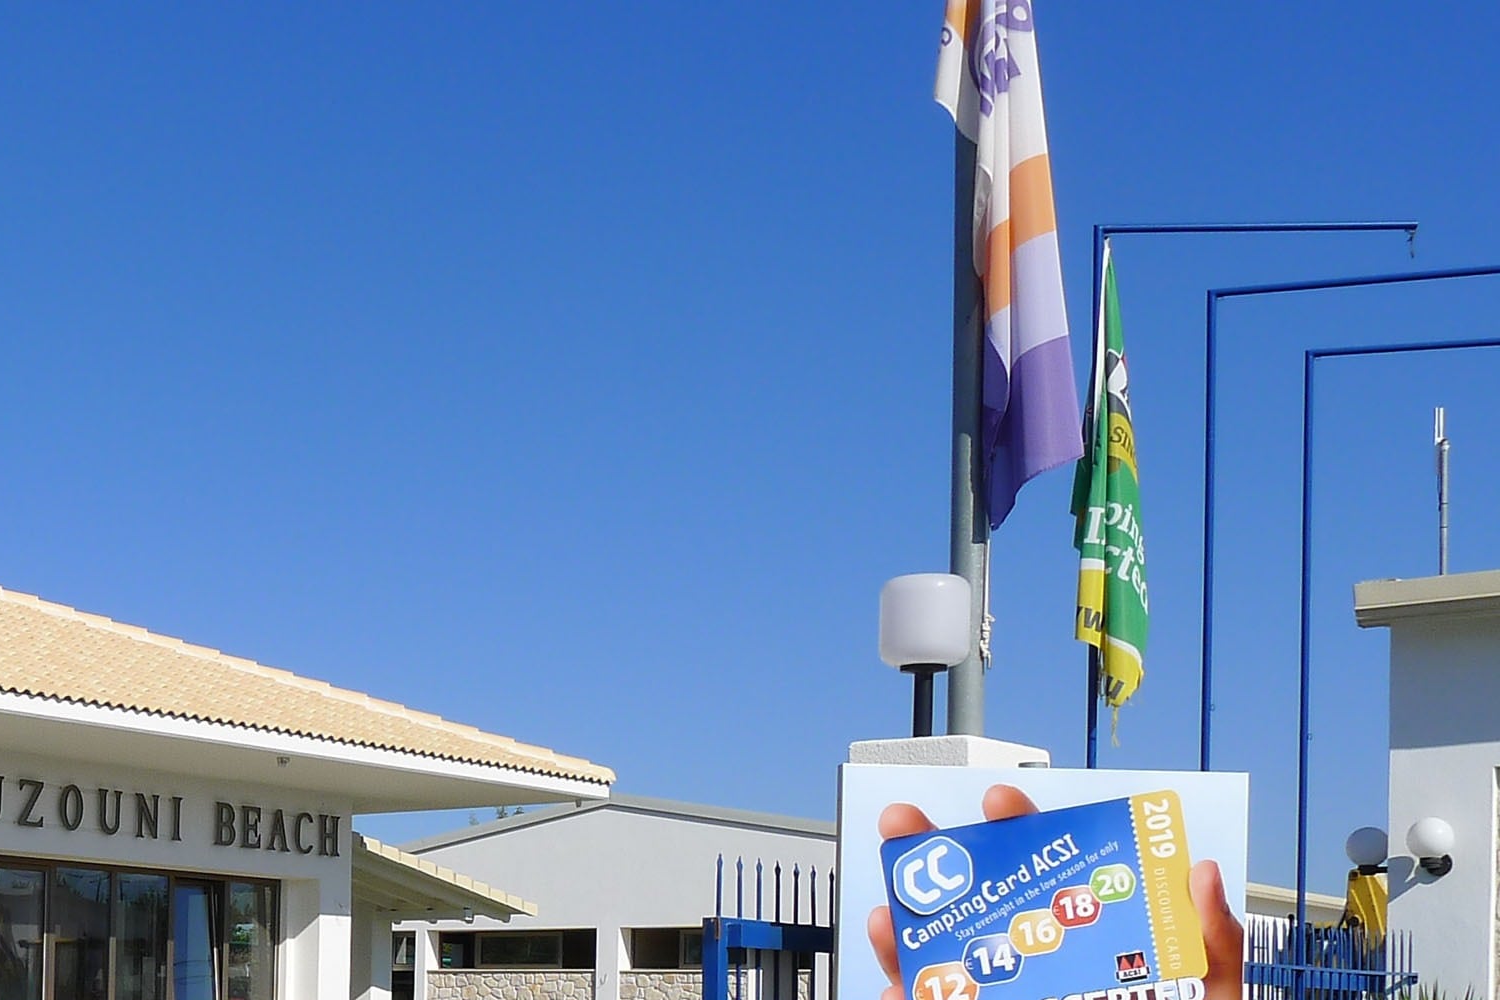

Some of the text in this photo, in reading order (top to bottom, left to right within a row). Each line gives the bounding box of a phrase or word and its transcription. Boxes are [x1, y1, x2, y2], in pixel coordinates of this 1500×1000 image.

[213, 800, 342, 858] BEACH
[903, 844, 966, 905] CC
[902, 832, 1081, 950] CampingCard ACSI
[955, 839, 1120, 941] Stay overnight in the low season for only
[1143, 798, 1181, 970] 2019 DISCOUNT CARD
